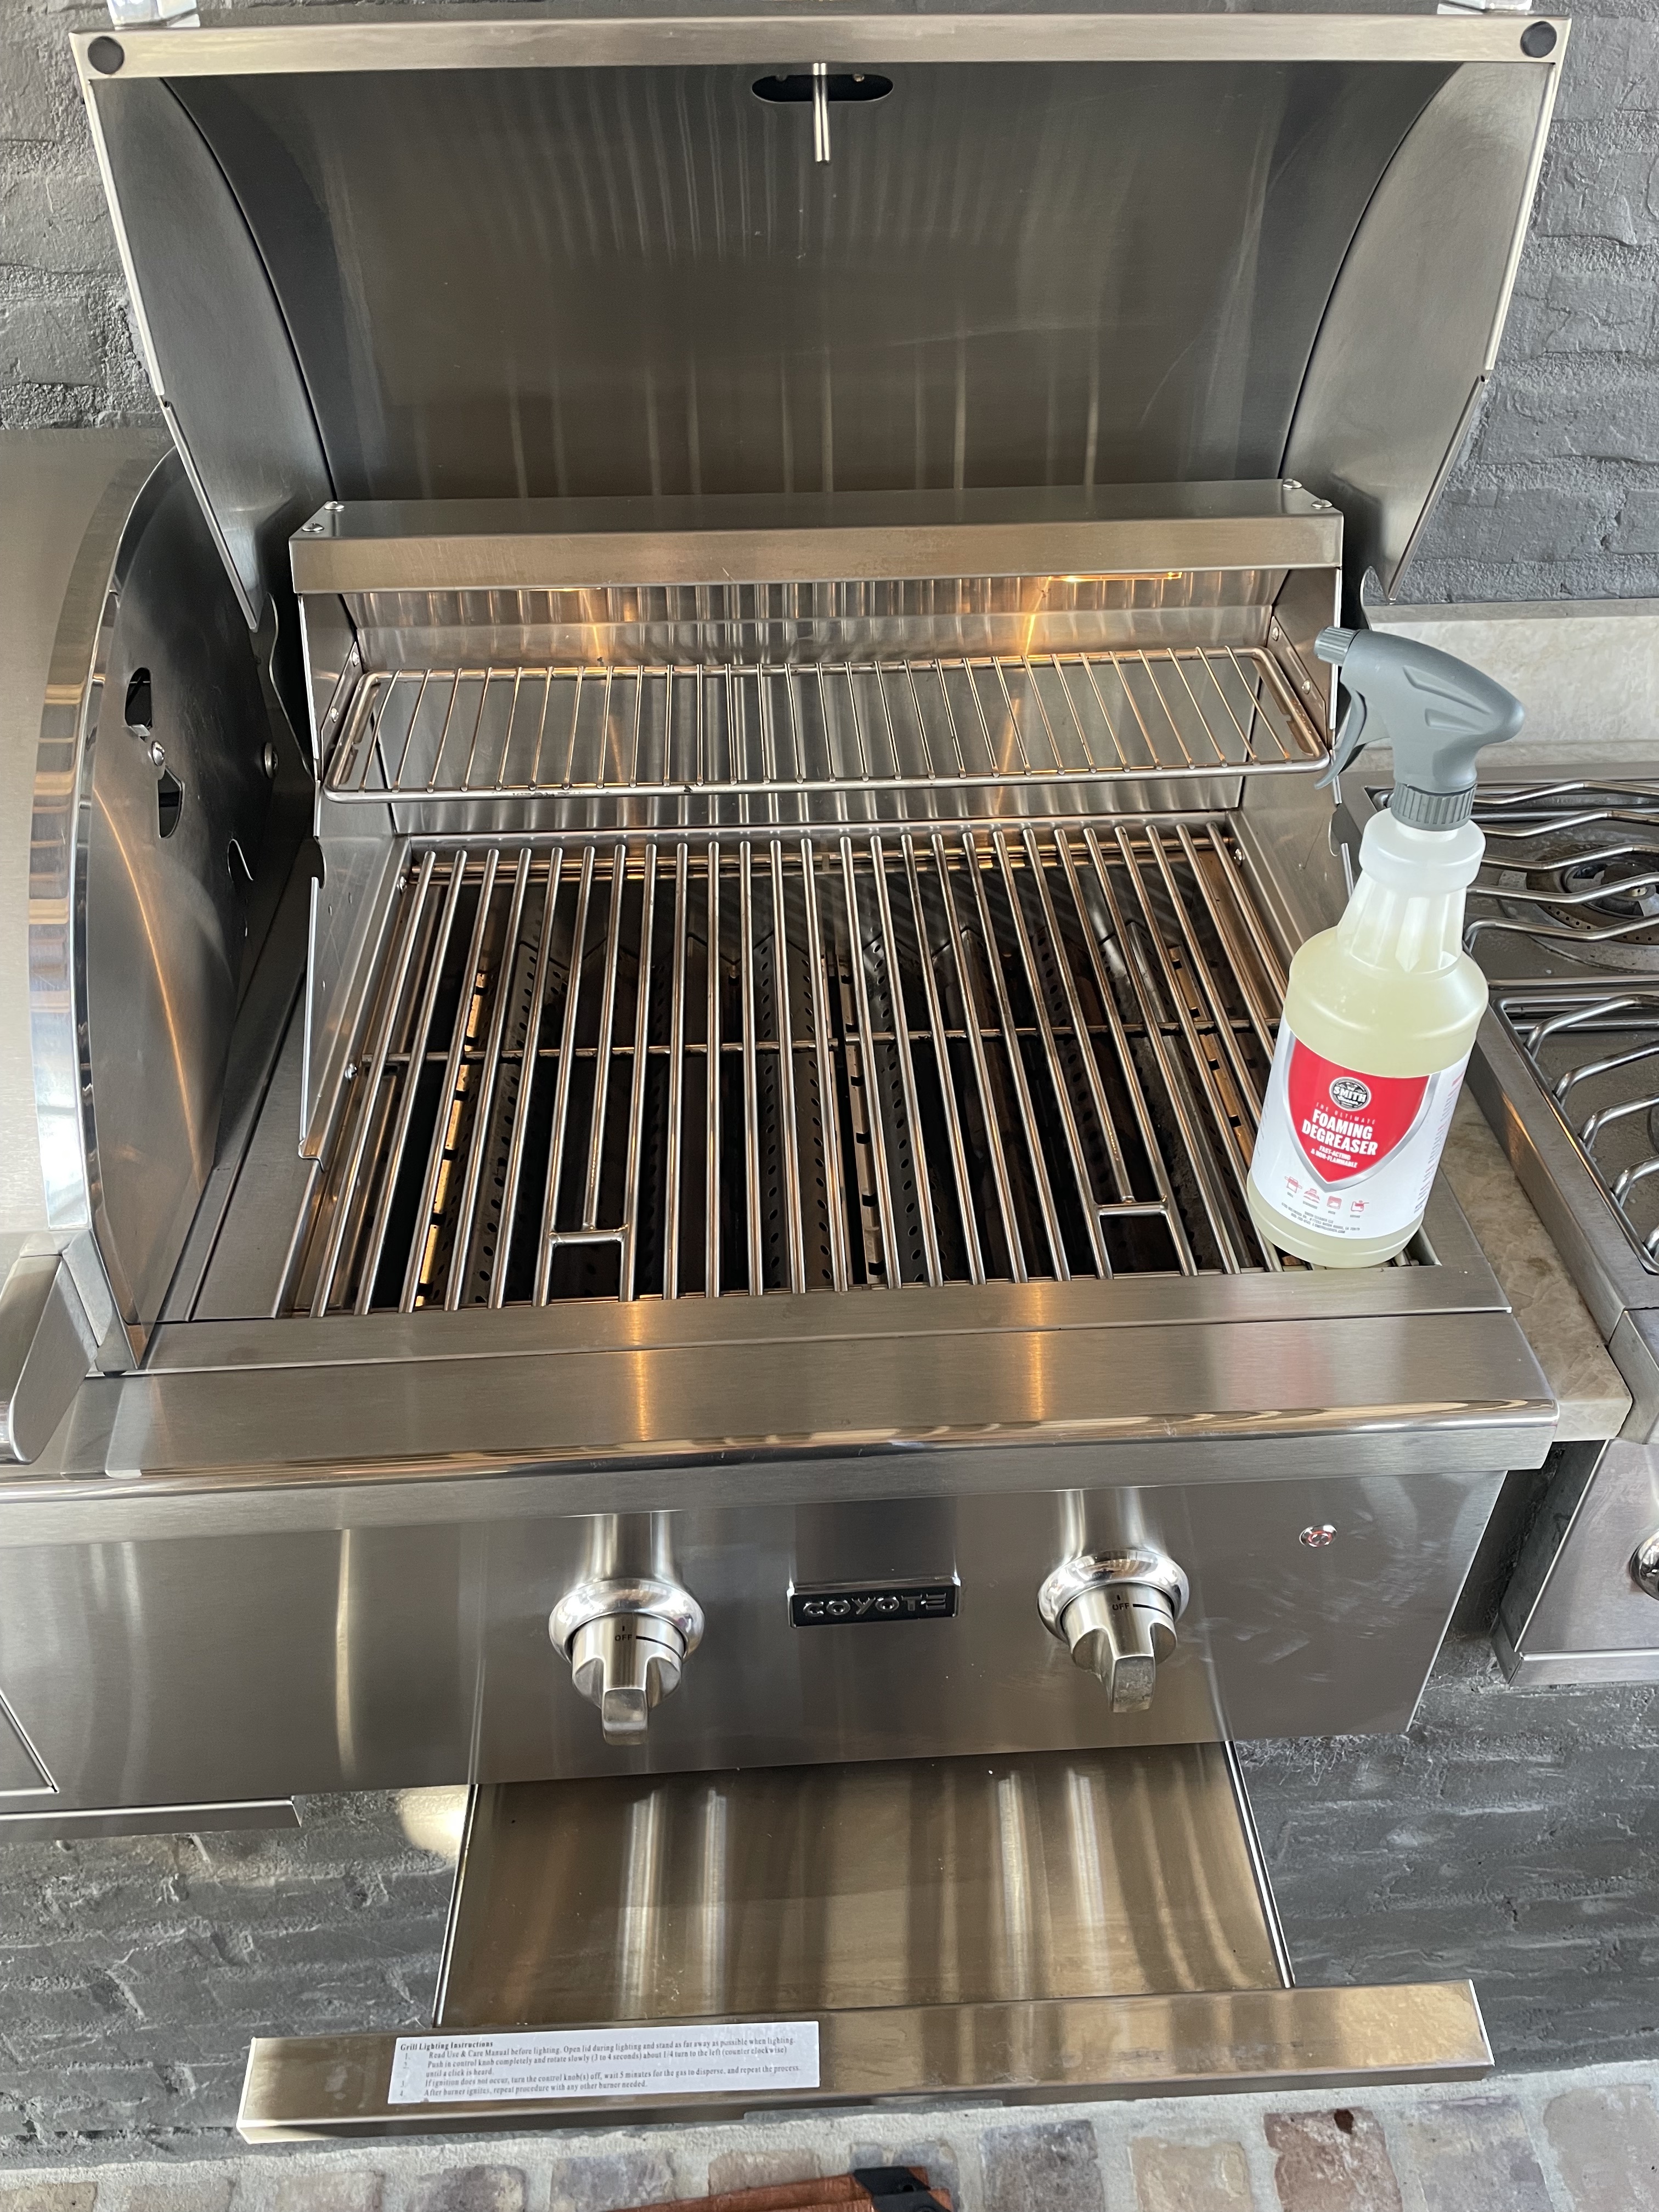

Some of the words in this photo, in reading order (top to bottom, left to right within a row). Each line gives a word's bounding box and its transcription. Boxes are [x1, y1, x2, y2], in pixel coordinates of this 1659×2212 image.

[1333, 1086, 1367, 1102] SMITH
[1312, 1109, 1373, 1139] FOAMING
[1334, 1110, 1376, 1125] ULTIMATE
[1301, 1119, 1378, 1155] DEGREASER
[1316, 1149, 1358, 1167] NON-FLAMMABLE
[1319, 1146, 1351, 1160] FAST-ACTING
[803, 1592, 946, 1618] COYOTE
[1111, 1602, 1130, 1611] OFF
[614, 1633, 633, 1641] OFF
[419, 2042, 448, 2051] Lighting
[485, 2048, 509, 2056] Manual
[534, 2047, 562, 2055] lighting.
[563, 2046, 580, 2054] Open
[592, 2044, 614, 2052] during
[616, 2044, 641, 2052] lighting
[720, 2039, 747, 2047] possible
[768, 2037, 795, 2045] lighting.
[496, 2057, 532, 2066] completely
[568, 2055, 589, 2063] slowly
[751, 2046, 787, 2055] clockwise)
[432, 2079, 459, 2087] ignition
[590, 2072, 602, 2080] off,
[740, 2066, 761, 2075] repeat
[467, 2087, 492, 2096] ignites,
[494, 2086, 514, 2095] repeat
[516, 2085, 549, 2094] procedure
